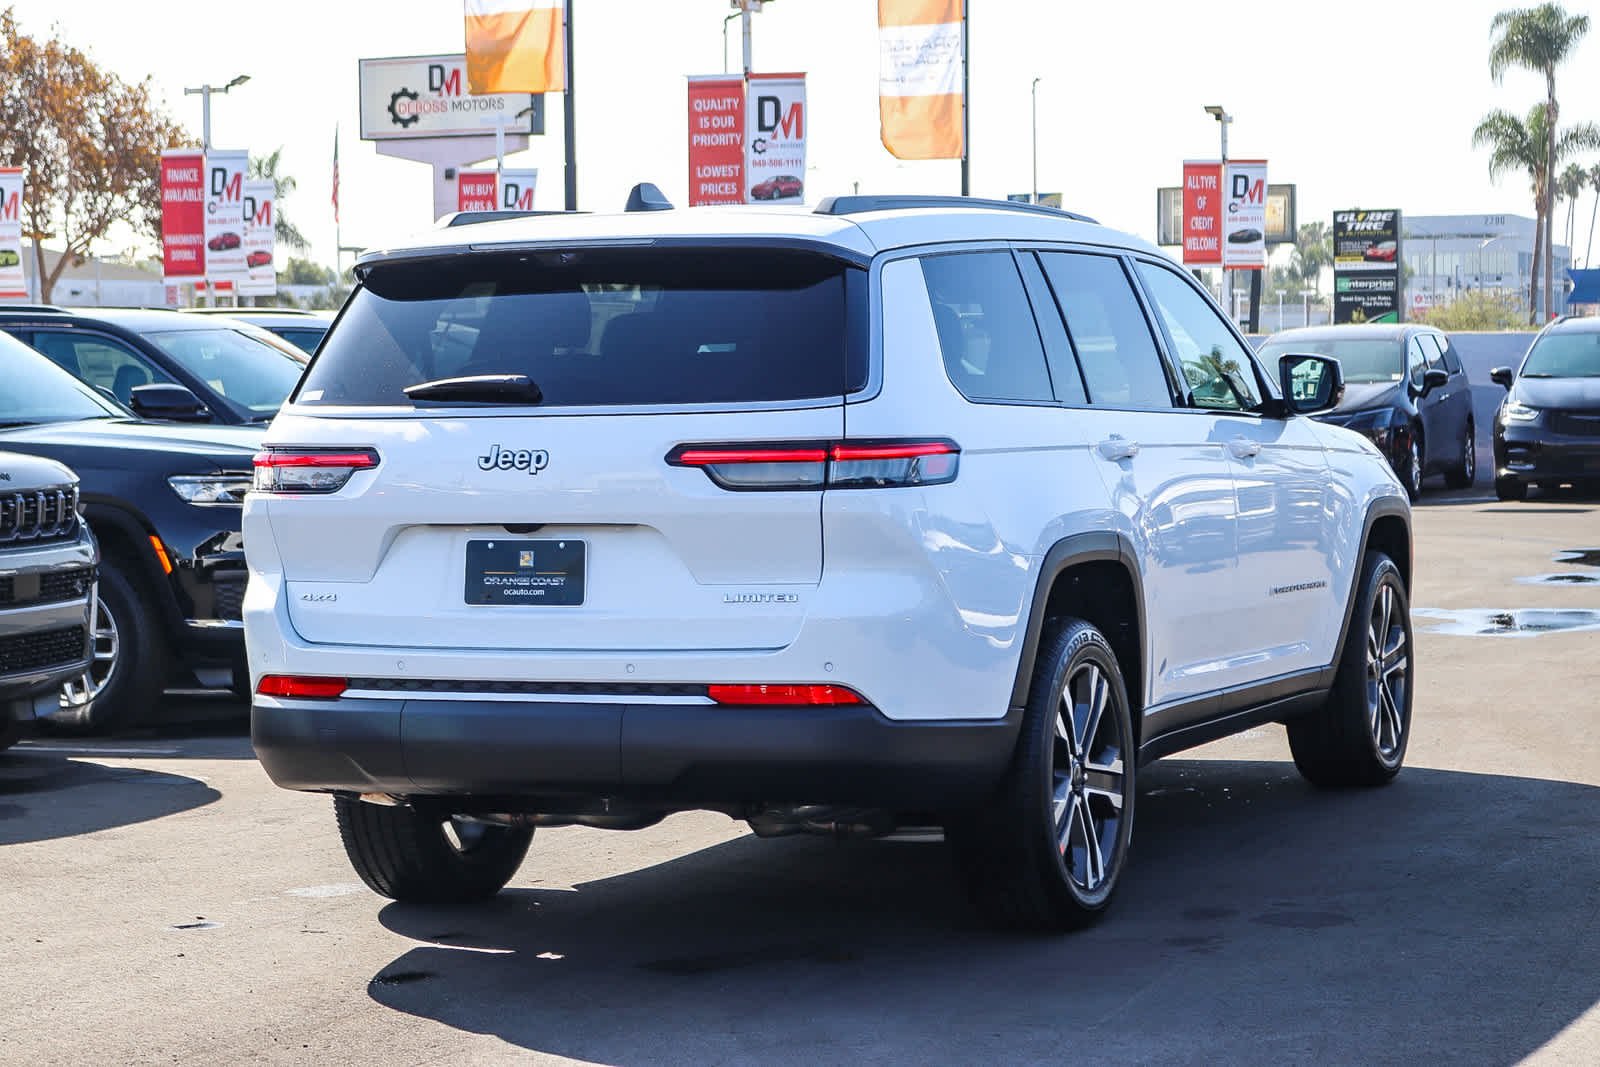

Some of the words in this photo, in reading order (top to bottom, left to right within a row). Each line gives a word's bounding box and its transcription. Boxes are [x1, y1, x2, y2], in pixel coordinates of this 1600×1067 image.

[428, 64, 461, 96] DM
[452, 97, 505, 113] MOTORS
[694, 97, 740, 112] QUALITY
[700, 116, 710, 129] IS
[712, 115, 736, 129] OUR
[758, 95, 803, 140] DM
[693, 133, 742, 147] PRIORITY
[167, 168, 198, 182] FINANCE
[696, 164, 741, 178] LOWEST
[212, 168, 242, 202] DM
[462, 184, 476, 195] WE
[477, 184, 494, 195] BUY
[701, 183, 737, 195] PRICES
[1188, 176, 1200, 190] ALL
[1201, 175, 1217, 189] TYPE
[1232, 174, 1265, 204] DM
[164, 188, 204, 202] AVAILABLE
[504, 183, 534, 211] DM
[1197, 196, 1207, 210] OF
[243, 197, 271, 226] DM
[1191, 216, 1214, 230] CREDIT
[1346, 221, 1386, 231] TIRE
[1186, 237, 1218, 251] WELCOME
[1341, 280, 1394, 290] enterprise
[478, 444, 550, 475] Jeep
[484, 577, 529, 586] ORANGE
[530, 577, 566, 586] COAST
[503, 588, 545, 596] ocauto.com
